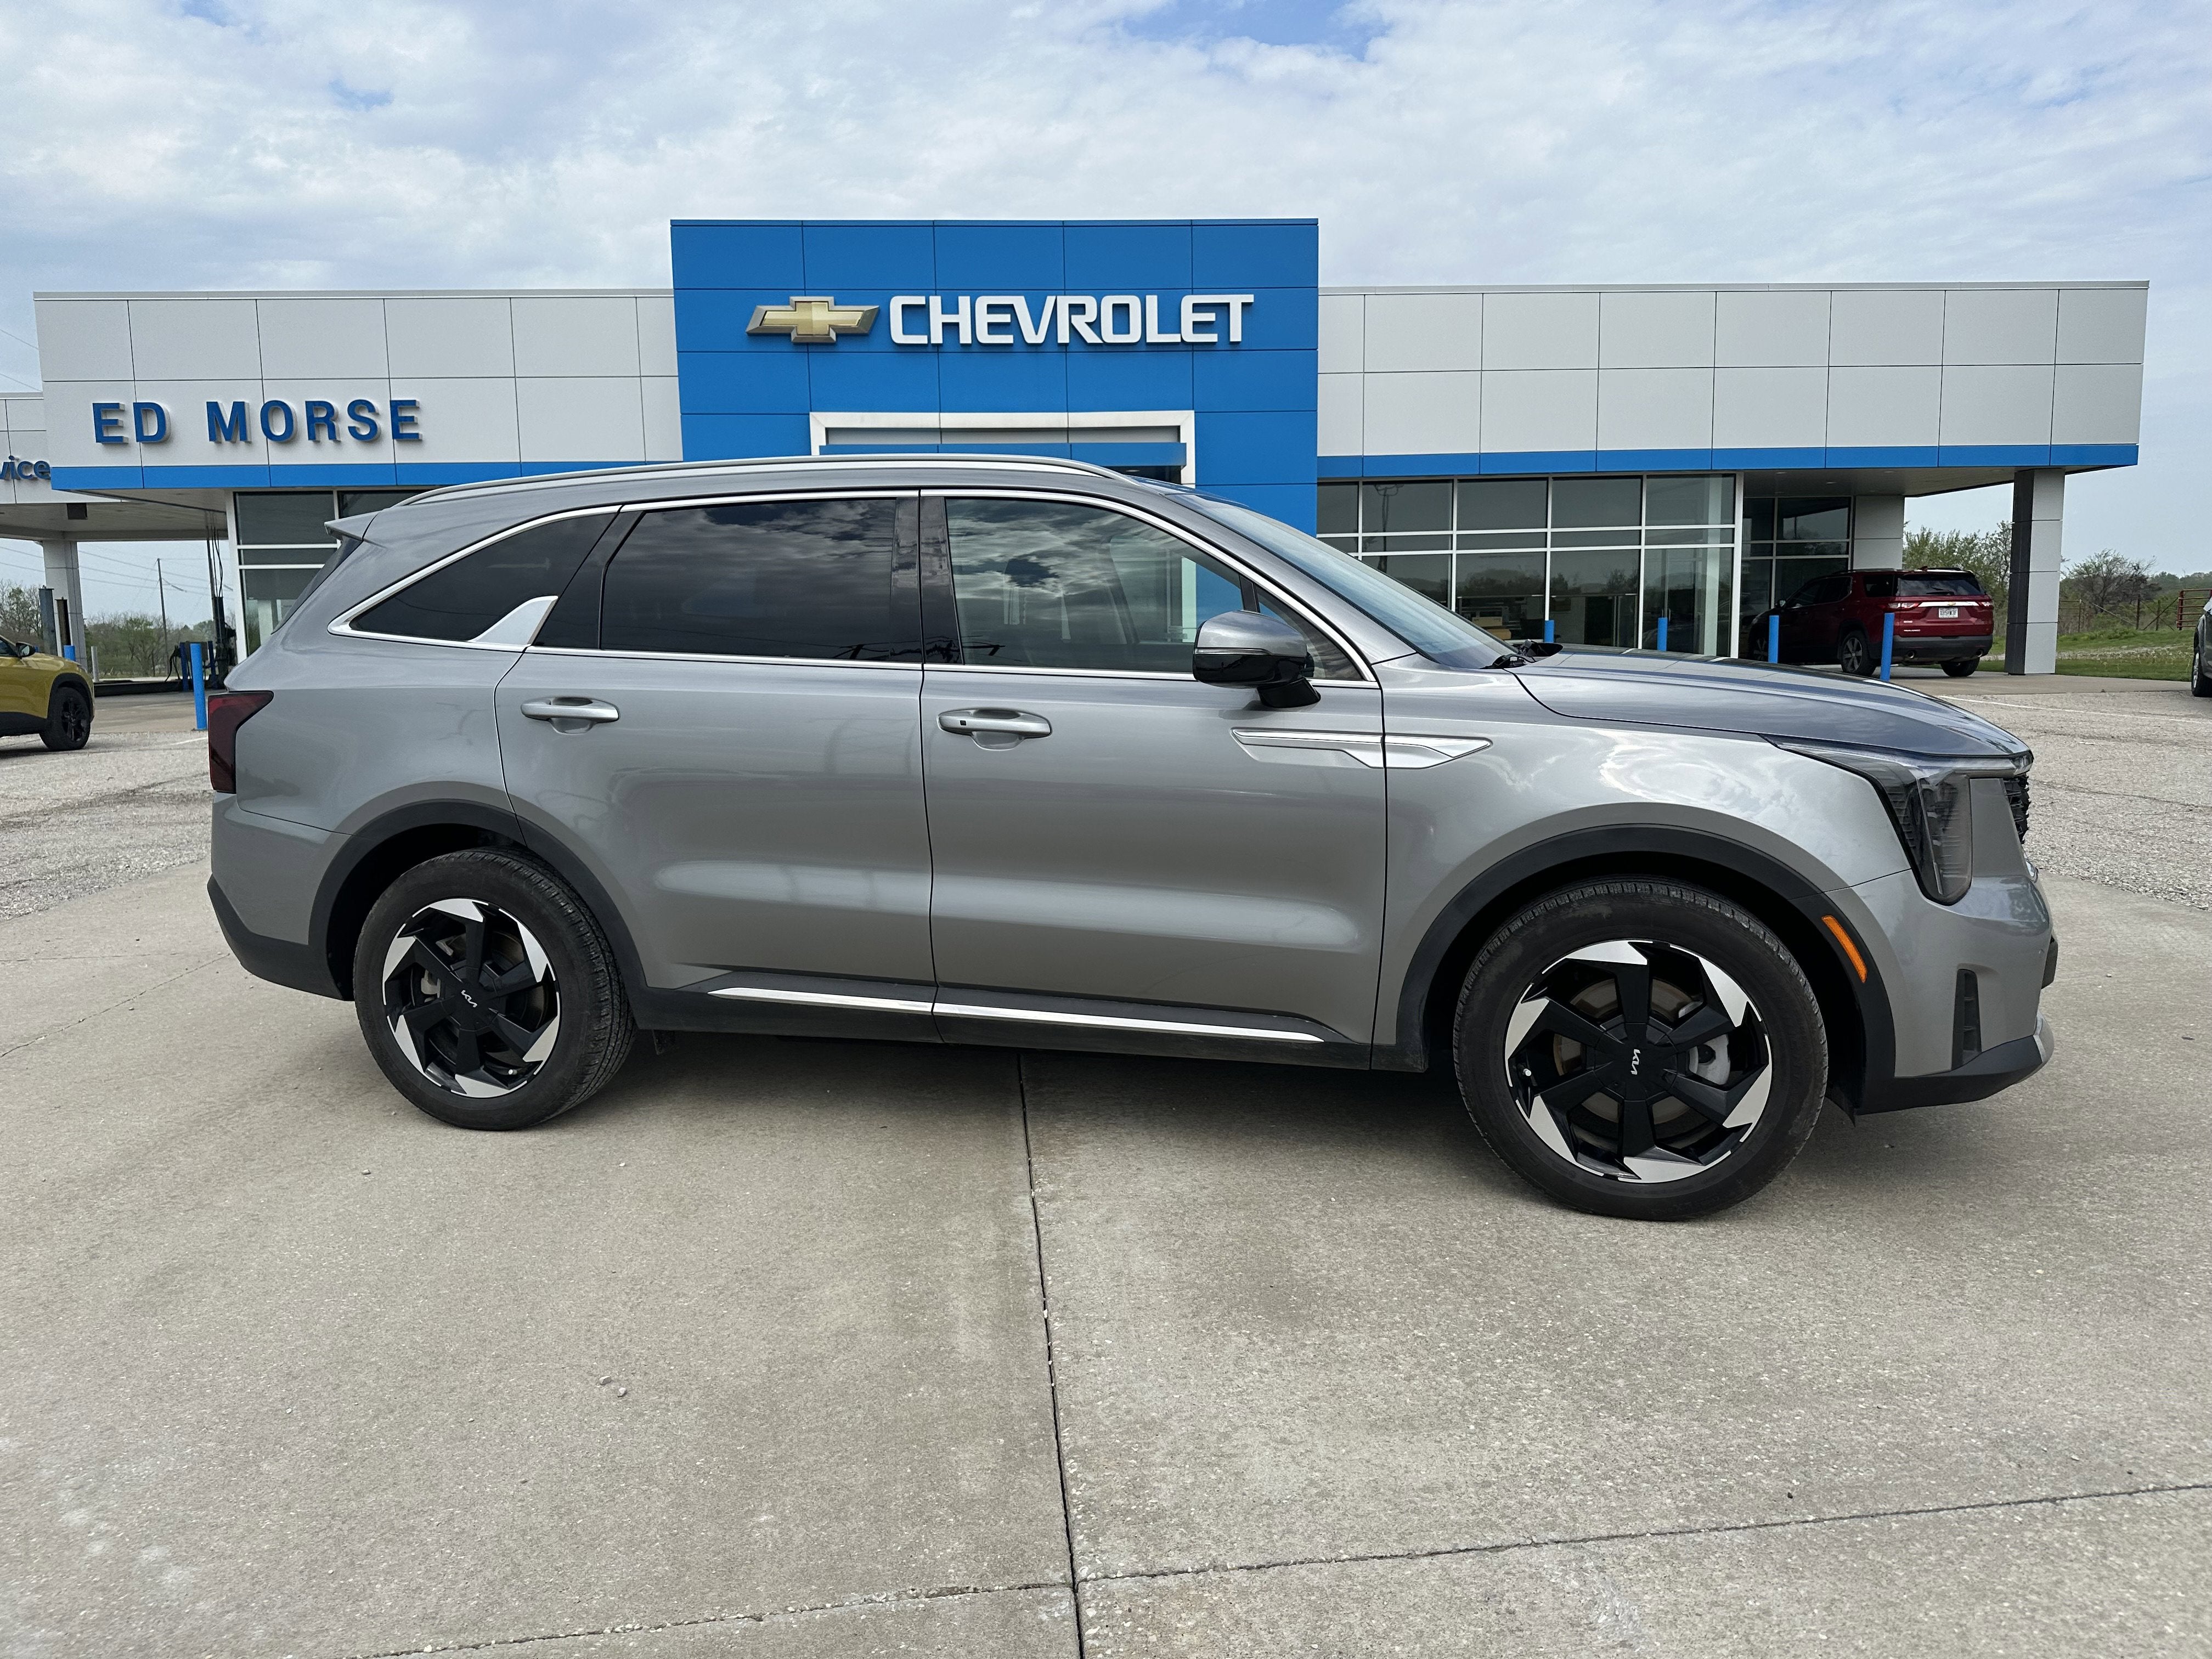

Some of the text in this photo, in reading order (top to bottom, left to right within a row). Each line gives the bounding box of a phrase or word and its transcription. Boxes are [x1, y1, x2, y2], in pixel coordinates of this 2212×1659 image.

[889, 294, 1255, 344] CHEVROLET
[92, 399, 422, 444] ED MORSE
